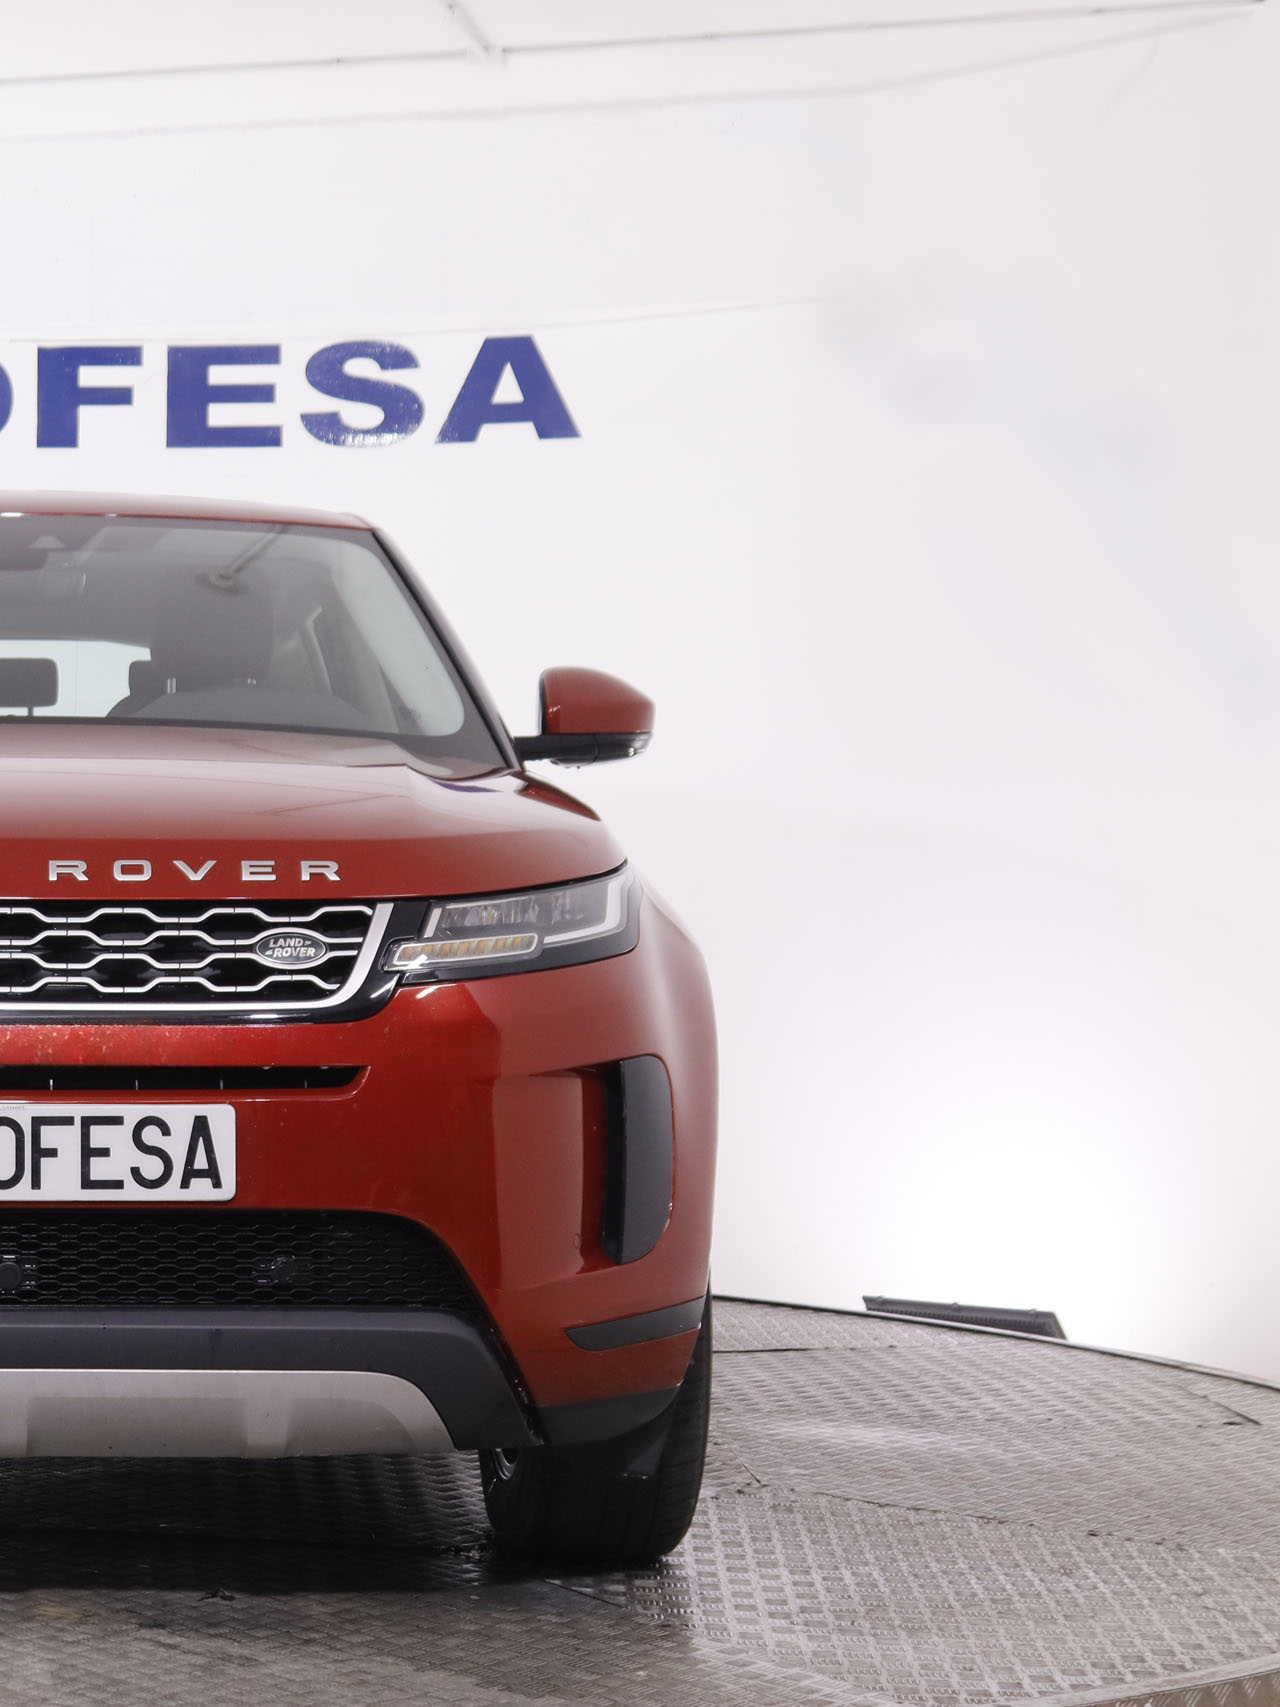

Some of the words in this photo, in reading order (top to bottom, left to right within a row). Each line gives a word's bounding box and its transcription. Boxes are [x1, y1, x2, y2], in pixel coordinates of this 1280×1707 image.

[47, 859, 342, 882] ROVER
[268, 937, 304, 948] LAND
[272, 946, 316, 958] ROVER
